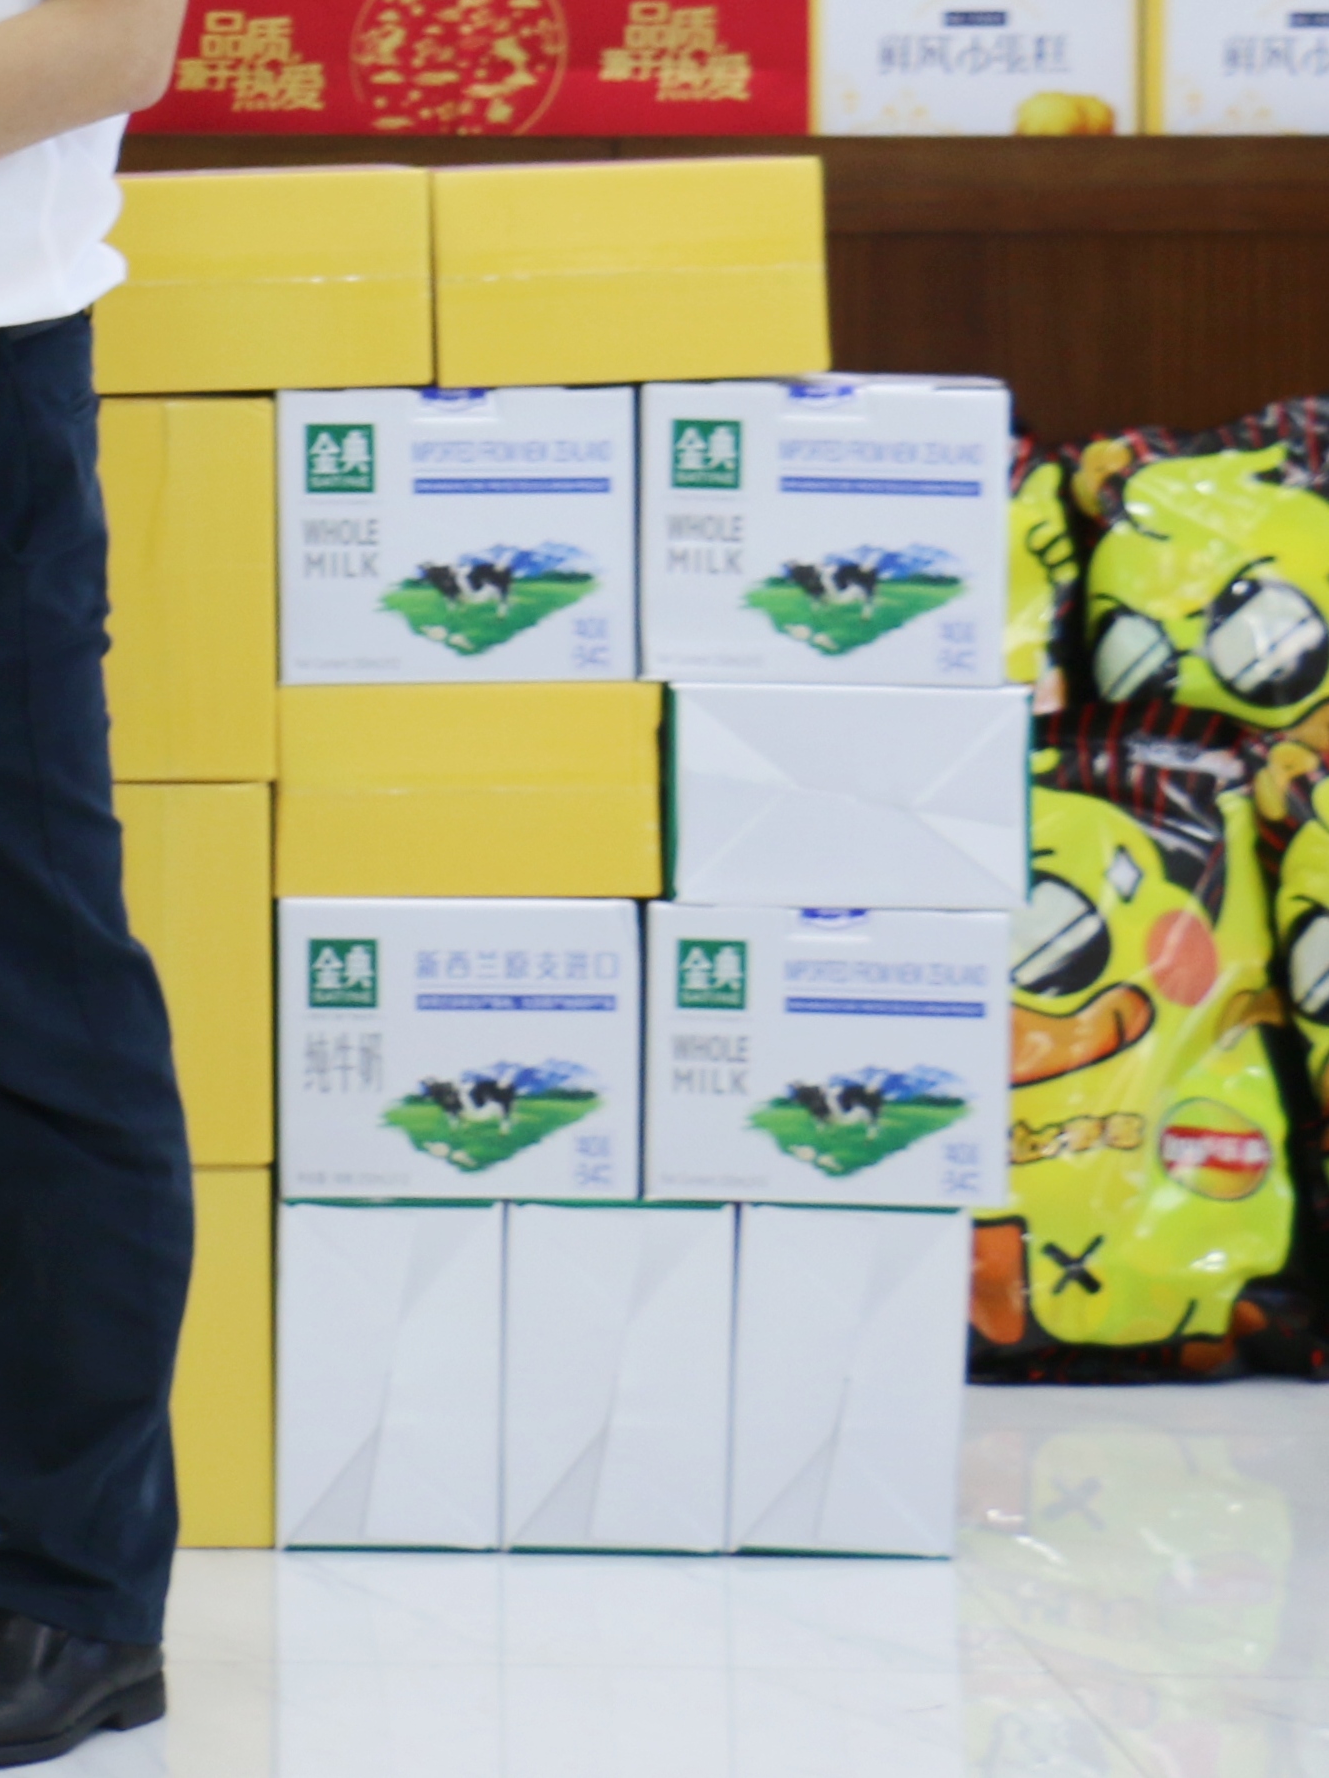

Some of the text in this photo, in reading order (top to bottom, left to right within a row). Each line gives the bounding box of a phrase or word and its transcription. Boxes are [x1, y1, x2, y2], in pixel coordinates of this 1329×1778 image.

[303, 551, 379, 579] MILK
[666, 547, 742, 575] MILK
[672, 1068, 749, 1096] MILK
